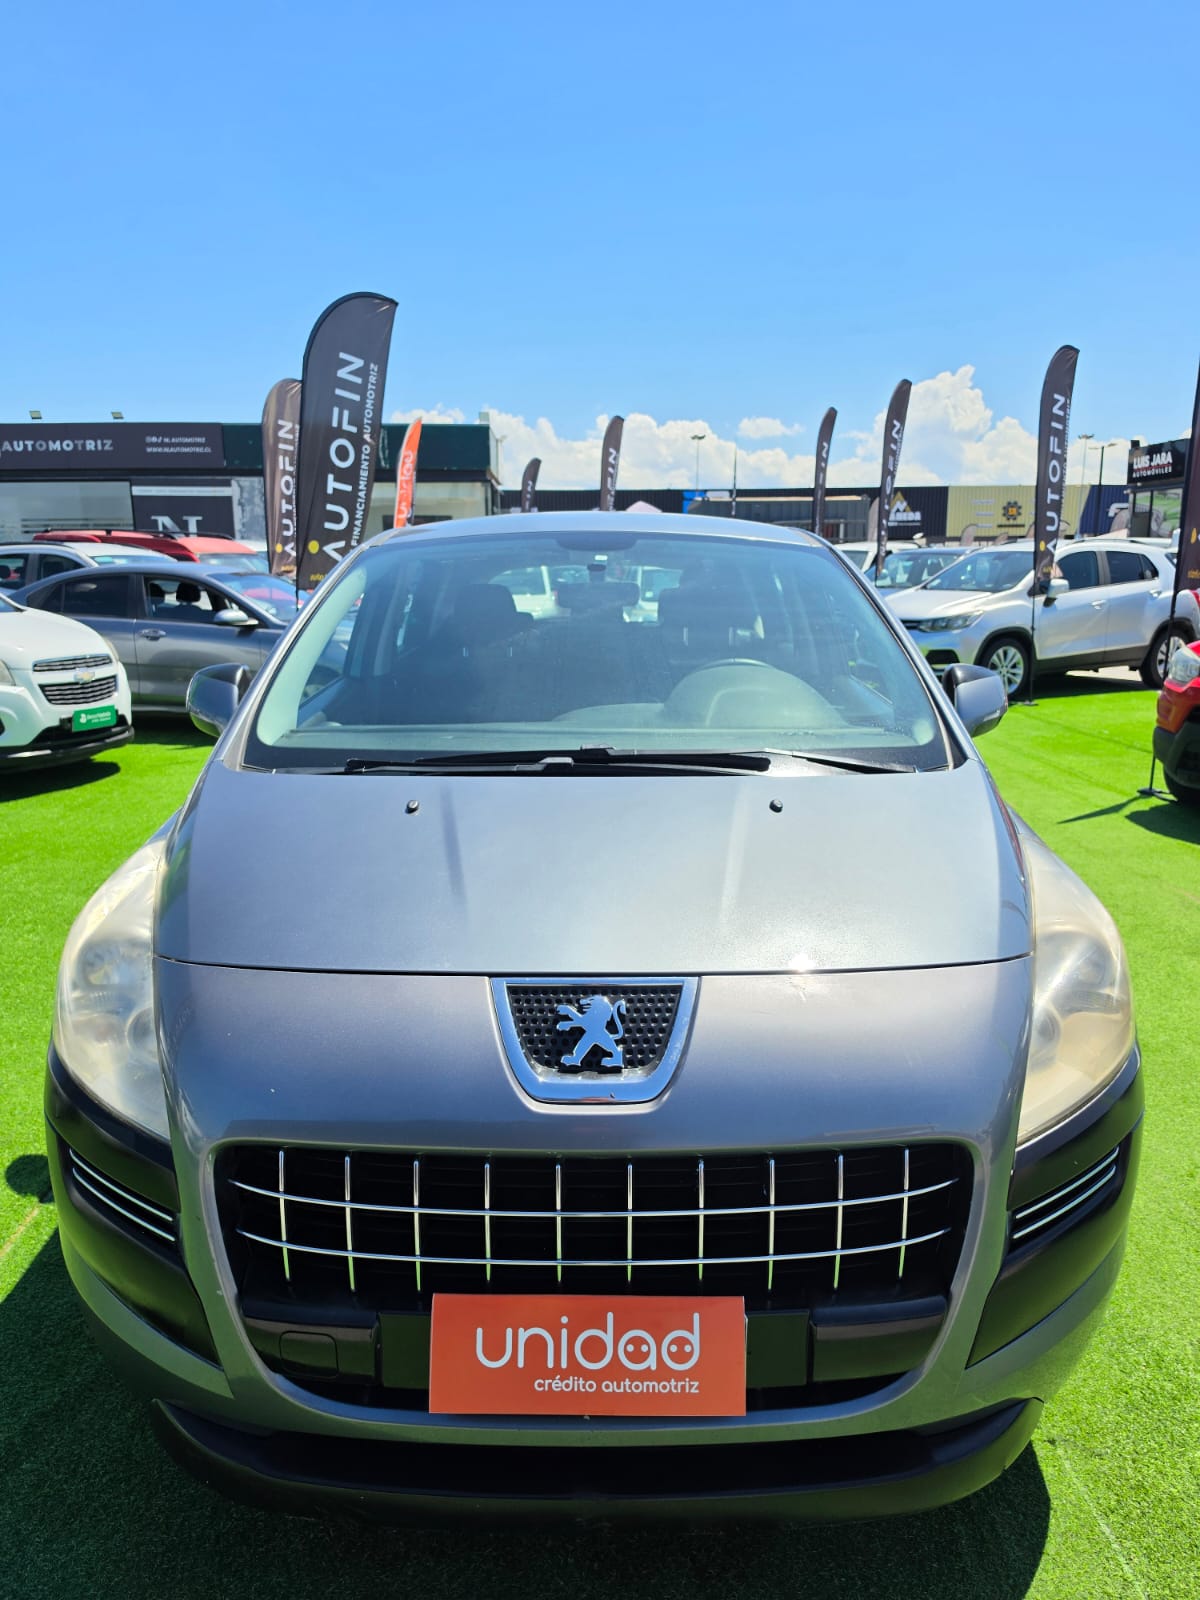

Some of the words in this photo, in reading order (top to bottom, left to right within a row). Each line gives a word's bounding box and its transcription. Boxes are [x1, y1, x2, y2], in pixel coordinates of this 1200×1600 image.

[2, 439, 114, 452] AUTOMOTRIZ
[277, 419, 297, 559] AUTOFIN
[322, 352, 365, 562] AUTOFIN
[351, 444, 371, 546] FINANCIAMIENTO
[363, 363, 379, 443] AUTOMOTRIZ
[1046, 393, 1066, 555] AUTOFIN
[1133, 455, 1150, 470] LUIS
[1150, 451, 1173, 467] JARA
[475, 1311, 700, 1371] unidad
[534, 1375, 597, 1393] crédito
[601, 1377, 700, 1394] automotriz
